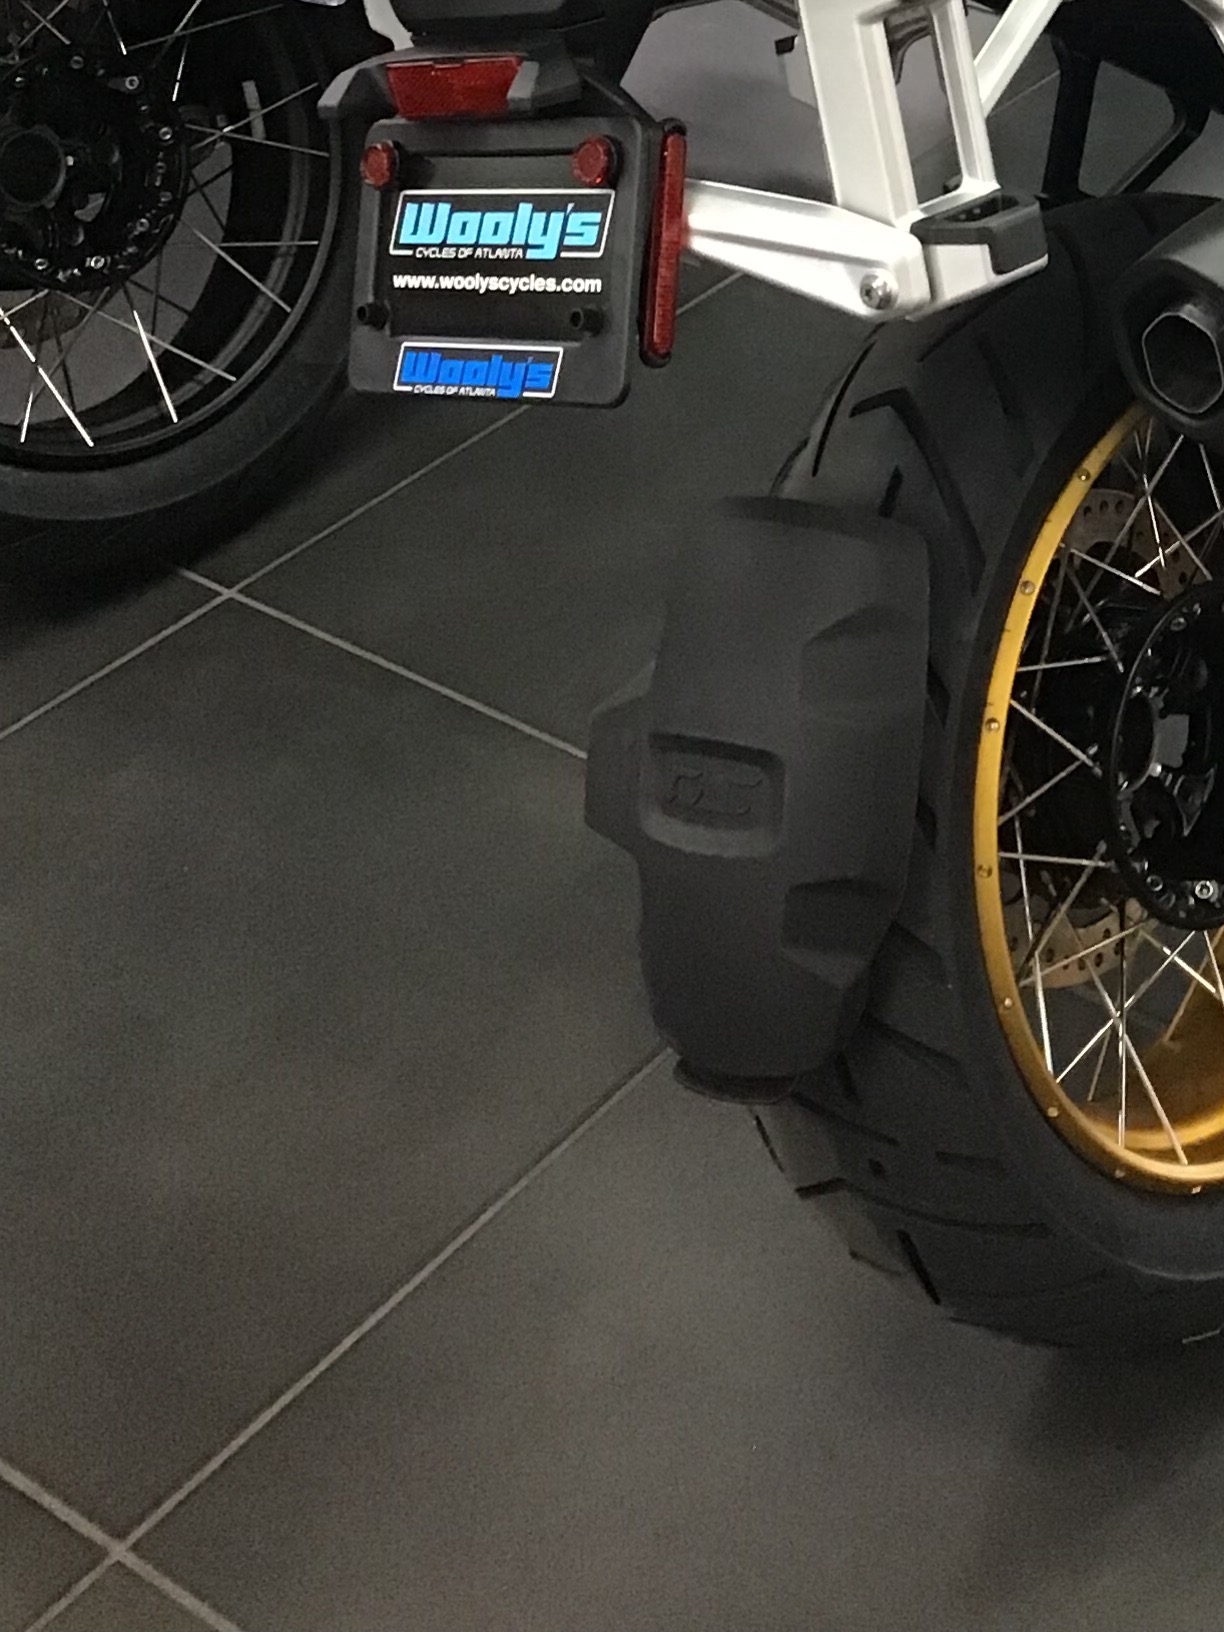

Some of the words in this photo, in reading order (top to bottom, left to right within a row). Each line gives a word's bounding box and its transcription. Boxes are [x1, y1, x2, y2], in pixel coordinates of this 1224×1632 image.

[399, 202, 602, 260] Wooly's
[415, 247, 456, 259] CYCLES
[457, 248, 474, 259] OF
[474, 248, 524, 260] ATLANTA
[392, 272, 602, 294] www.woolyscycles.com
[401, 351, 554, 399] Wooly's
[413, 384, 446, 396] CYCLES
[459, 386, 496, 397] ATLANTA
